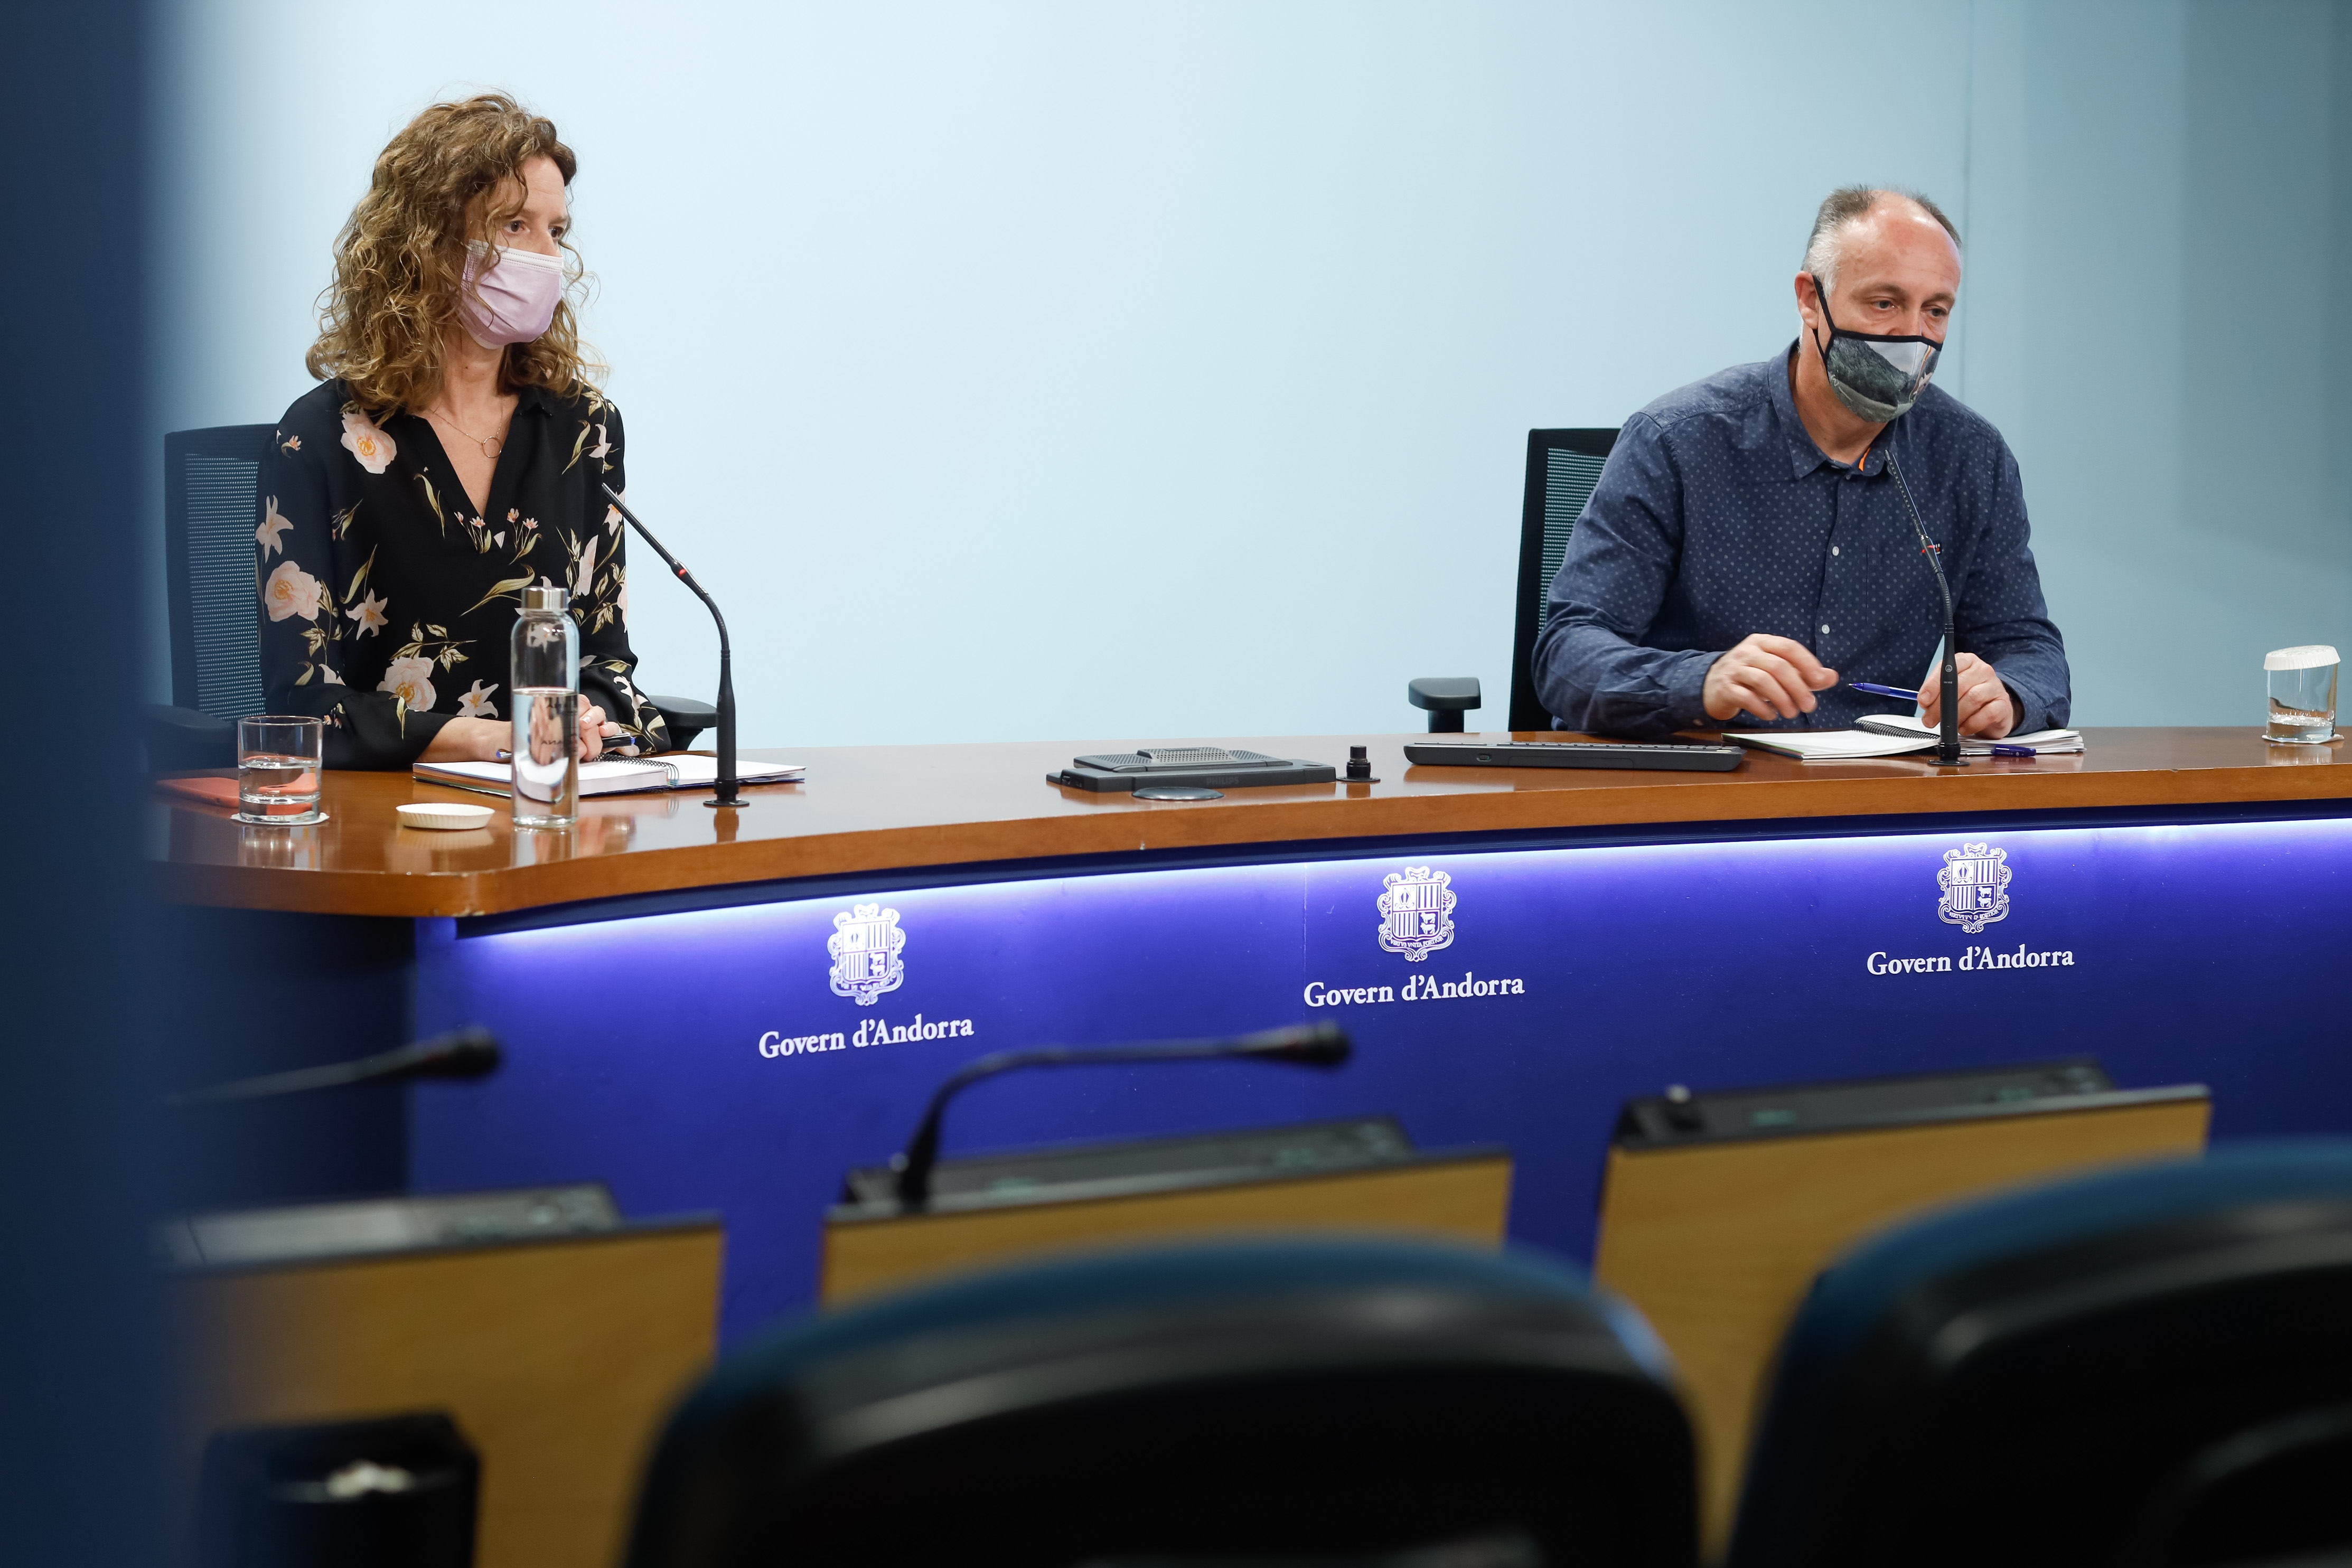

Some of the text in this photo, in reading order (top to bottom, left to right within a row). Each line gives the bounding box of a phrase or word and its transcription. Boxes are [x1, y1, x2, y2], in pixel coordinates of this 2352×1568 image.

[1206, 776, 1239, 785] PHILIPS
[1867, 943, 2075, 975] Govern d’Andorra
[1304, 972, 1525, 1007] Govern d’Andorra
[759, 1013, 974, 1058] Govern d’Andorra
